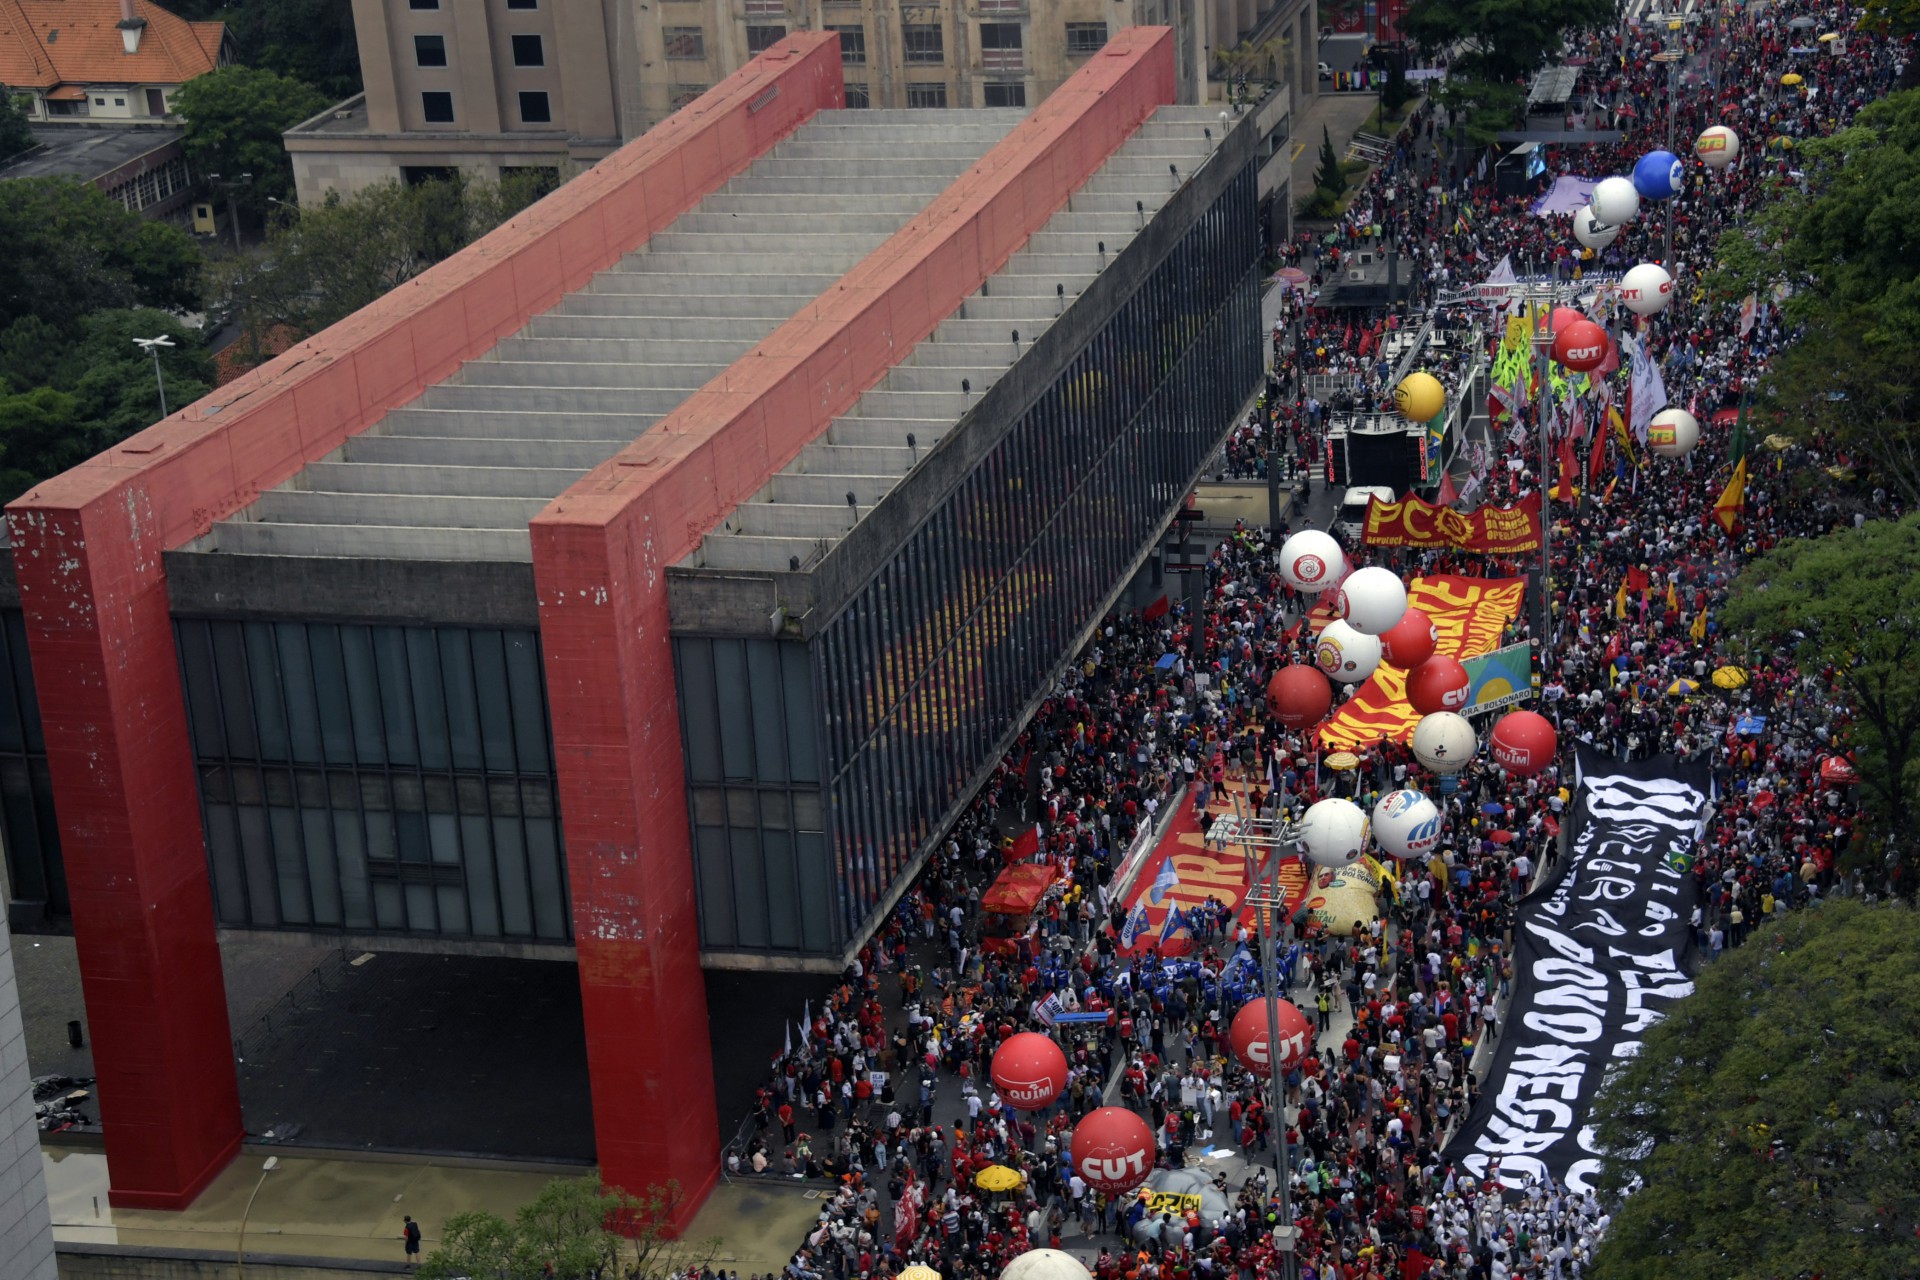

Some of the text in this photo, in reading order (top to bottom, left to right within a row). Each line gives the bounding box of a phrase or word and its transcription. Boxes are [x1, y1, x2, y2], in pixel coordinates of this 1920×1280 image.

[1622, 289, 1638, 299] UT
[1659, 281, 1673, 294] CU
[1567, 347, 1600, 361] CUT
[1483, 690, 1530, 711] BOLSONARO
[1247, 1030, 1305, 1064] CUT
[1462, 920, 1609, 1190] POVO NEGRO
[1082, 1148, 1146, 1180] CUT
